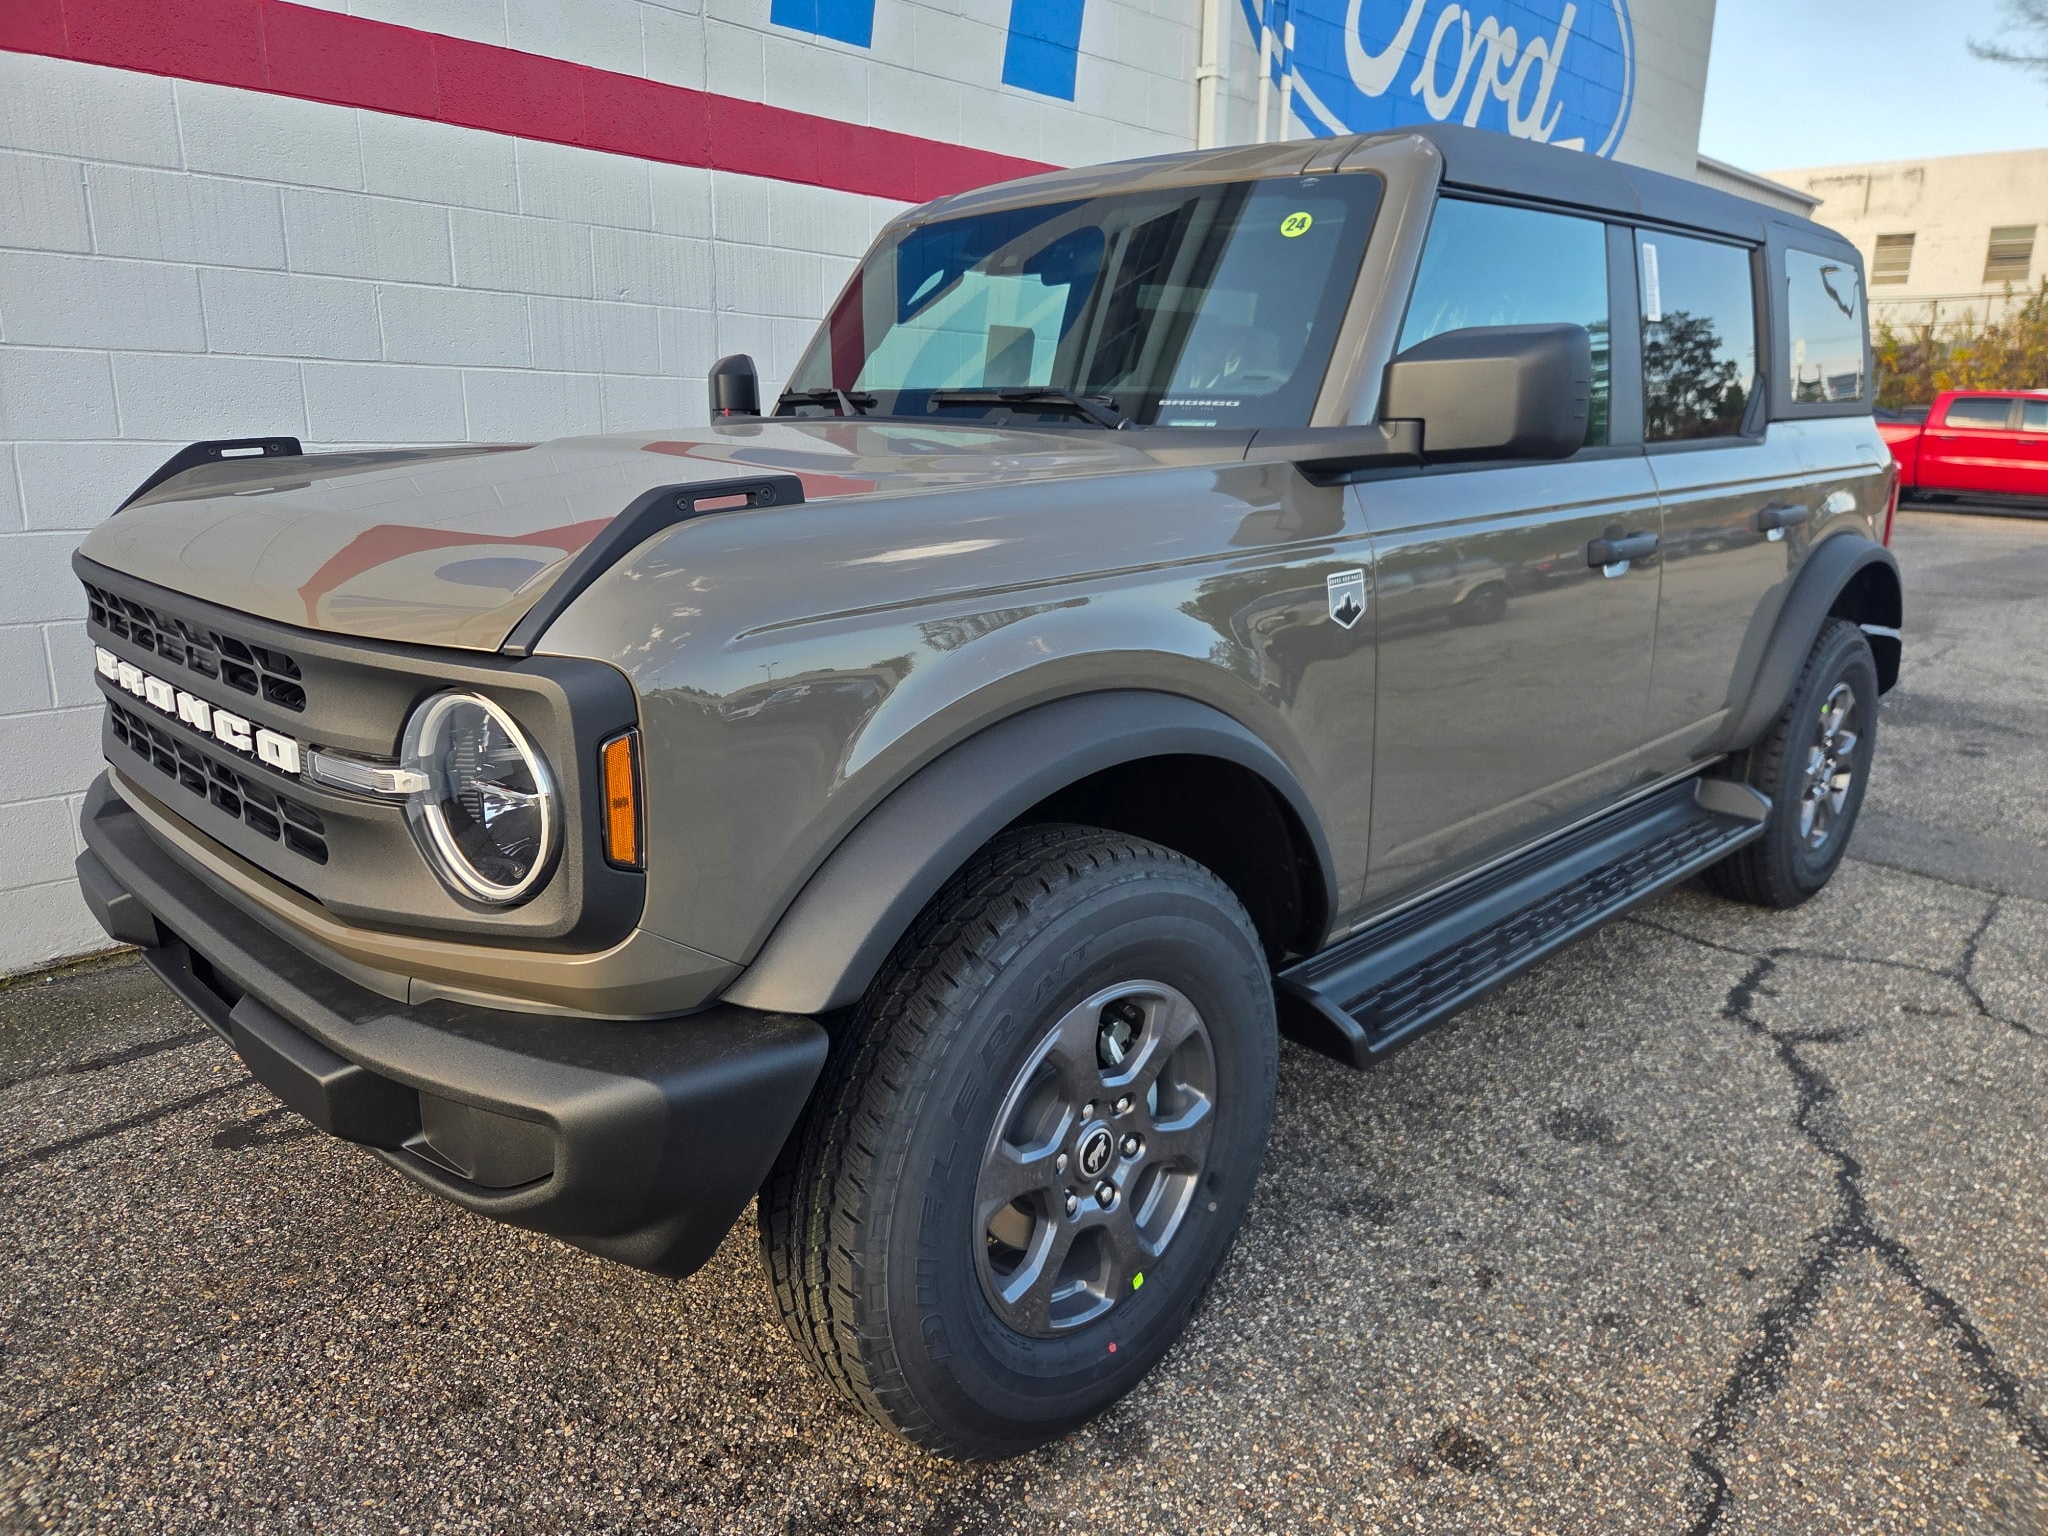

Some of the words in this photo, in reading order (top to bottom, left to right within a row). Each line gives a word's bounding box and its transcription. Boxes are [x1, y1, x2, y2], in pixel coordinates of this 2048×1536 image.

[1284, 216, 1308, 232] 24
[1158, 399, 1240, 407] BRONCO
[95, 646, 301, 773] BRONCO
